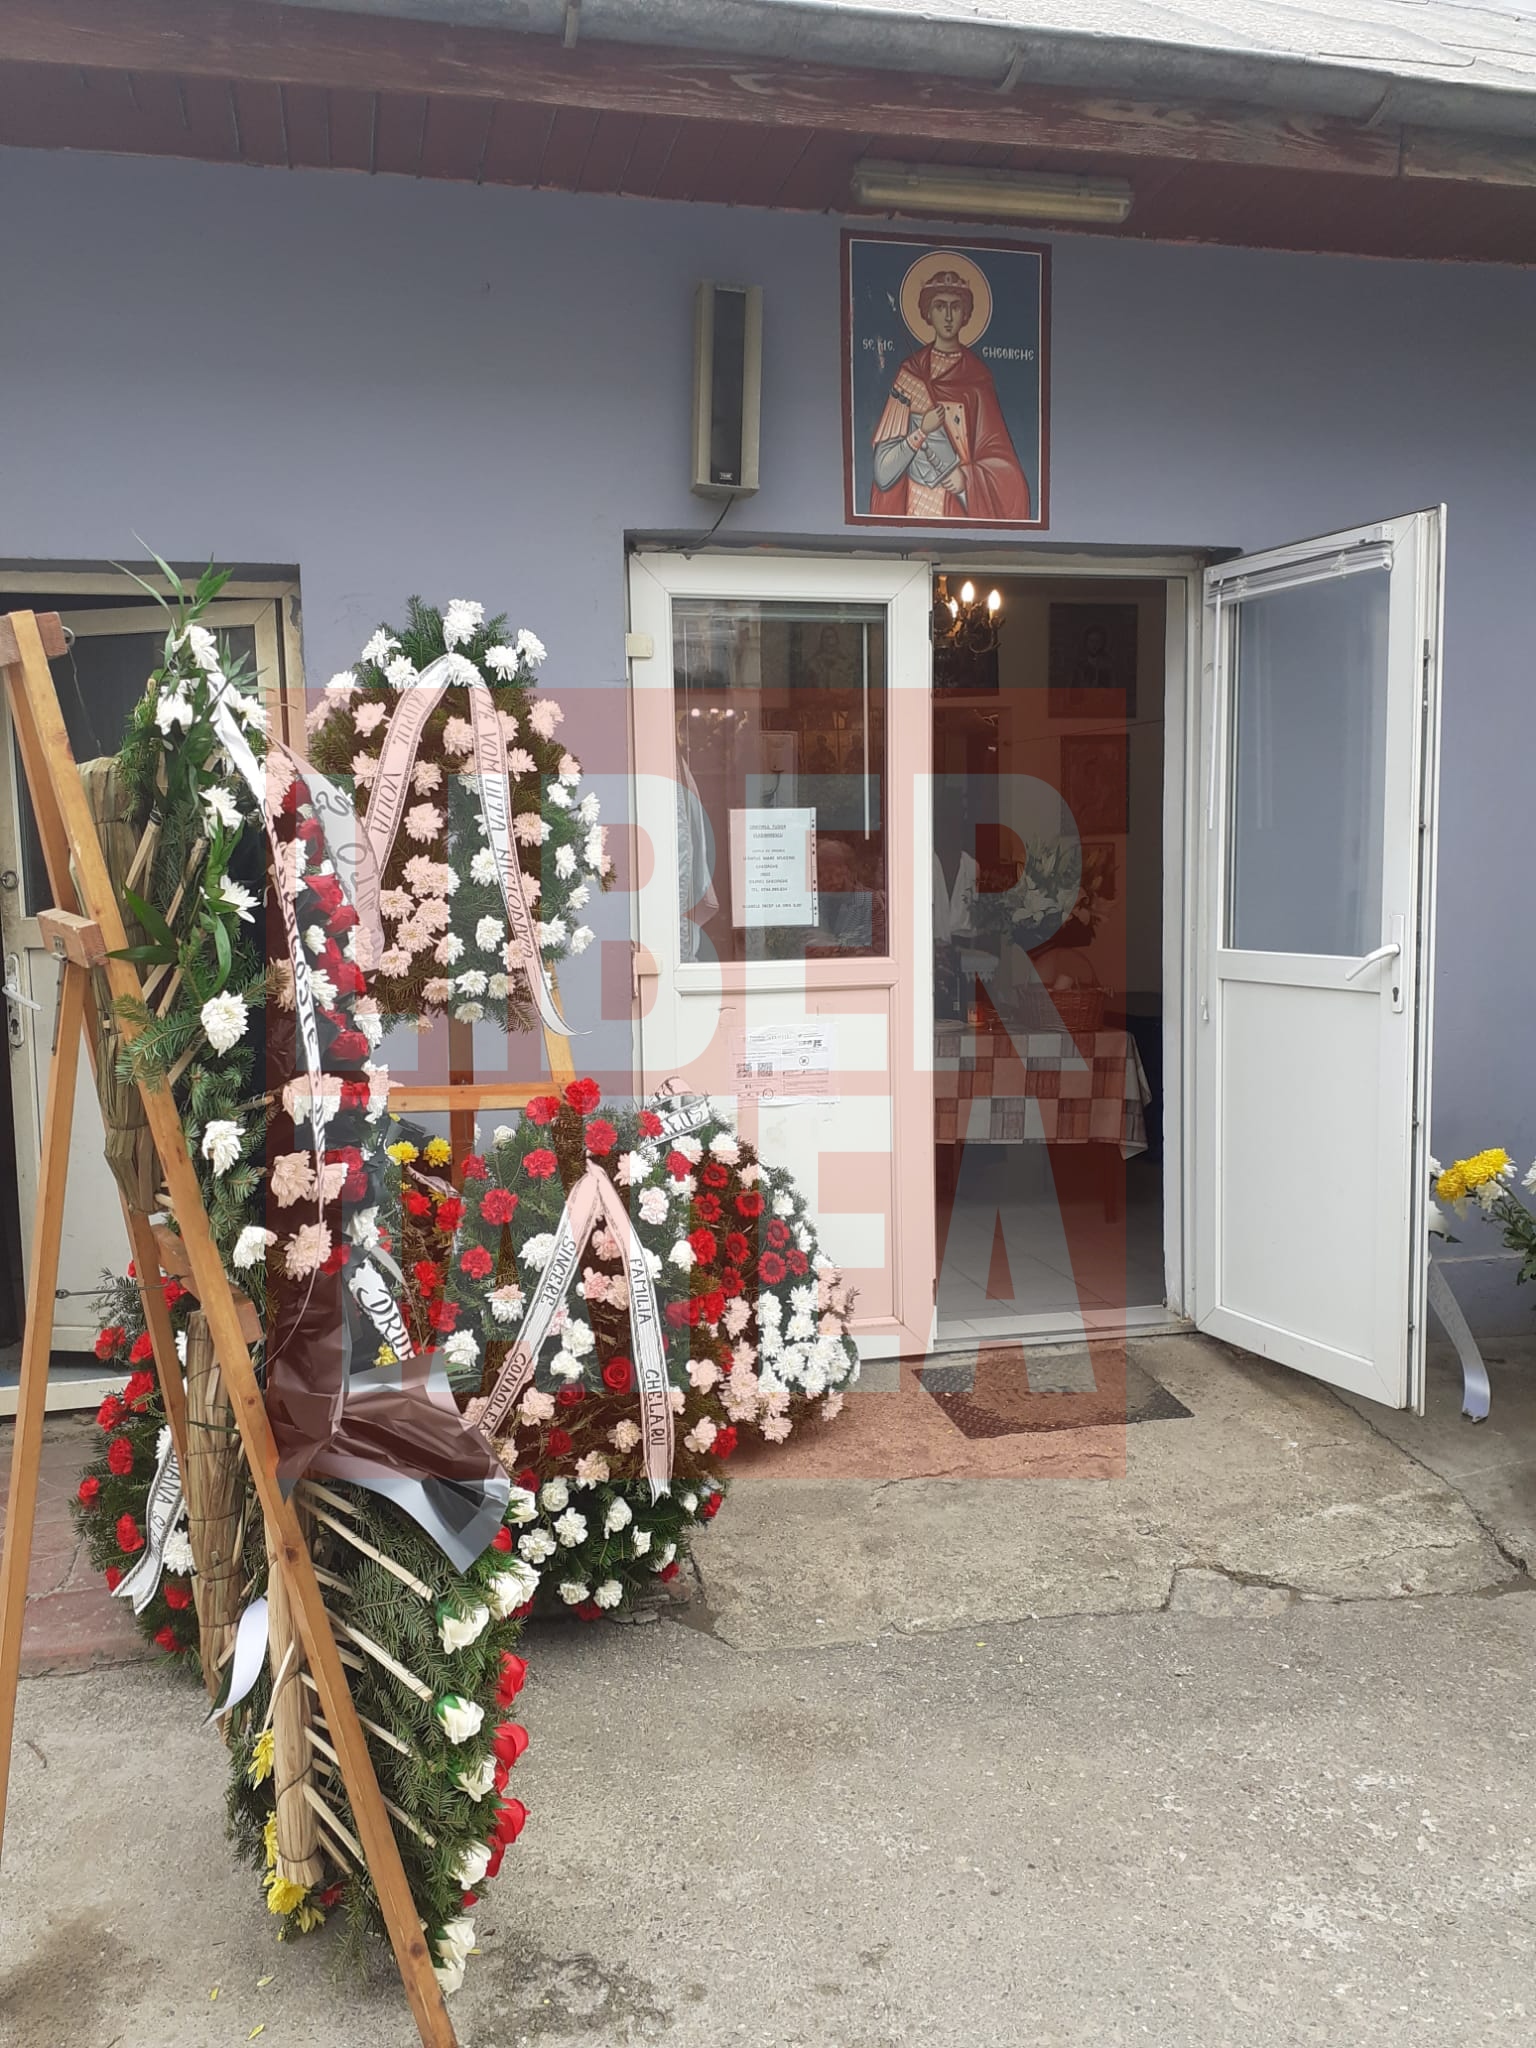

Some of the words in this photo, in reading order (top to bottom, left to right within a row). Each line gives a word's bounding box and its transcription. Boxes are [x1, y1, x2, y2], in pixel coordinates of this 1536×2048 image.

[480, 732, 501, 775] VOM
[541, 1235, 577, 1306] SINCERE
[630, 1258, 652, 1324] FAMILIA
